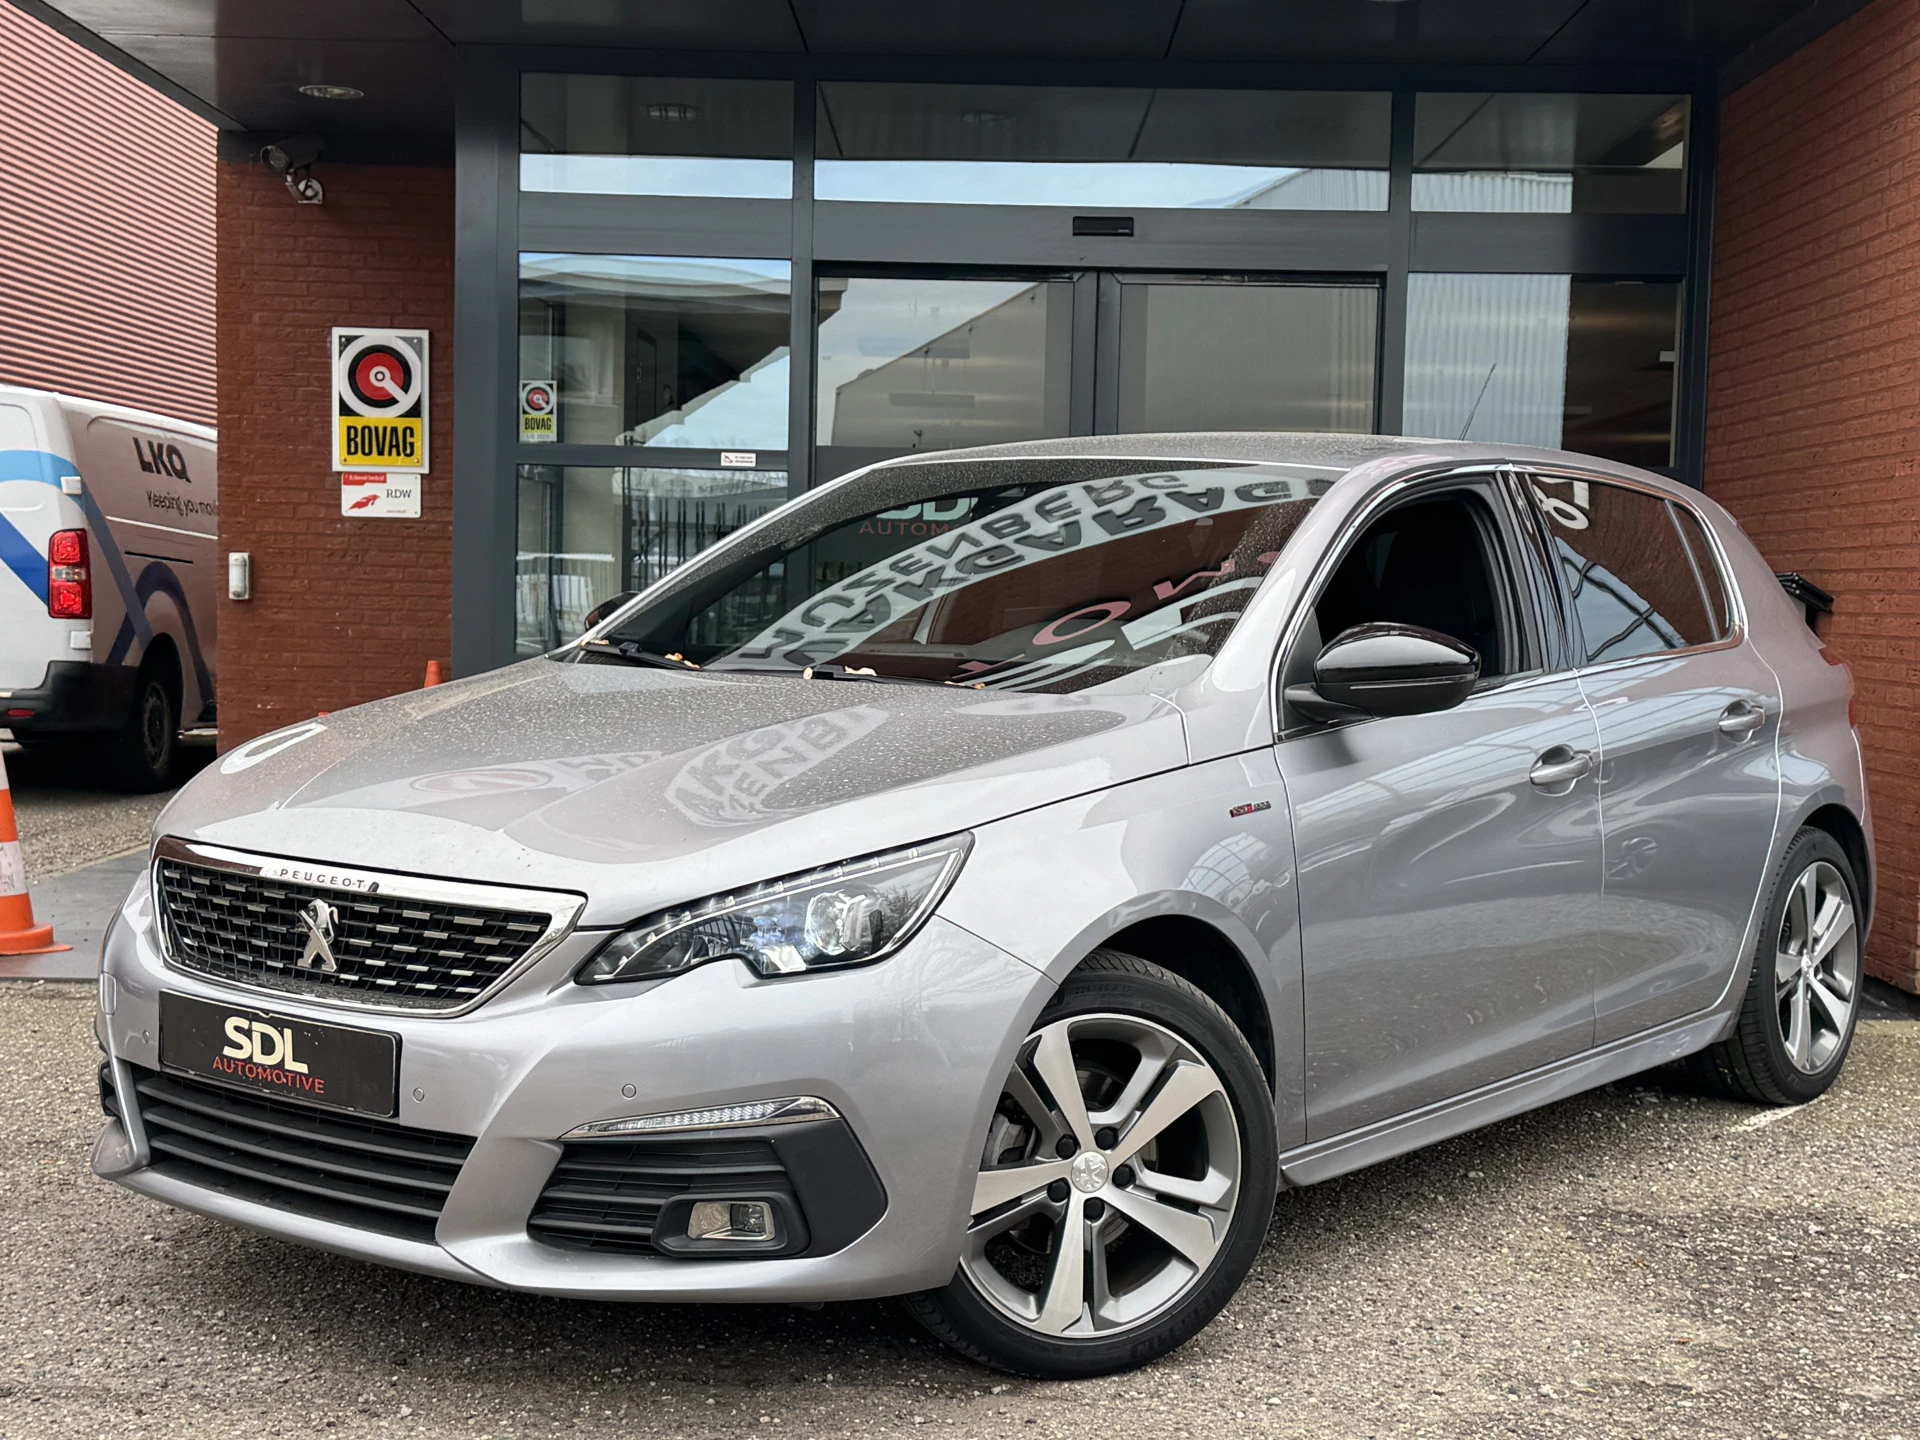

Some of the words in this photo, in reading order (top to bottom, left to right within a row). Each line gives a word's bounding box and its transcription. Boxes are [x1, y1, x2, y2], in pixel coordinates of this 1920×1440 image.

[524, 417, 552, 431] BOVAG
[346, 425, 416, 458] BOVAG
[132, 436, 192, 483] LKQ
[146, 490, 184, 517] Keeping
[183, 499, 199, 517] you
[386, 488, 412, 499] RDW
[859, 520, 962, 537] AUTOM
[279, 868, 366, 889] PEUGEOT
[222, 1016, 309, 1074] SDL
[212, 1056, 325, 1094] AUTOMOTIVE
